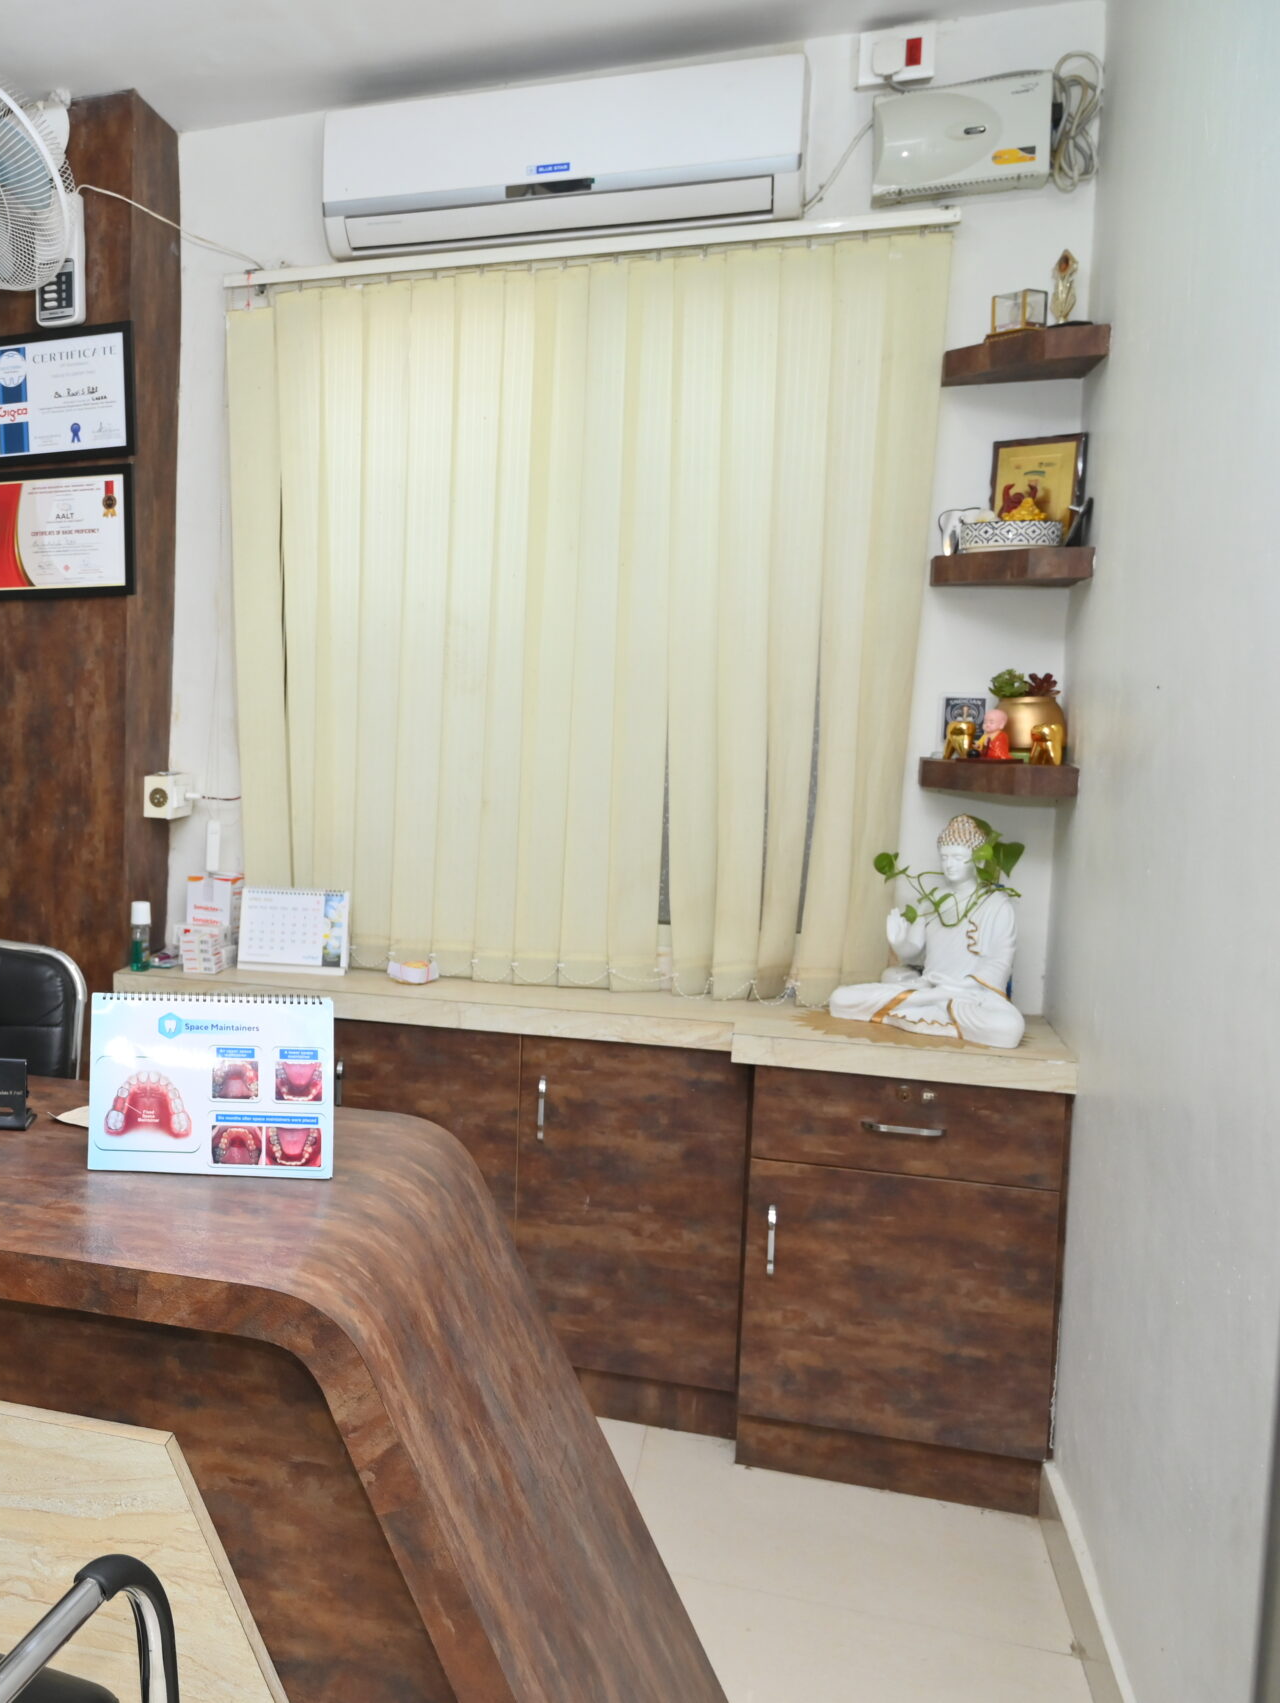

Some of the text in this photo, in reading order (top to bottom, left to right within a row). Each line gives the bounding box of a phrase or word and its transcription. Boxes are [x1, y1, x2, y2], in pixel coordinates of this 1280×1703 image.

[32, 345, 117, 364] CERTIFICATE
[55, 512, 75, 520] AALT
[185, 1023, 260, 1032] Space Maintainers
